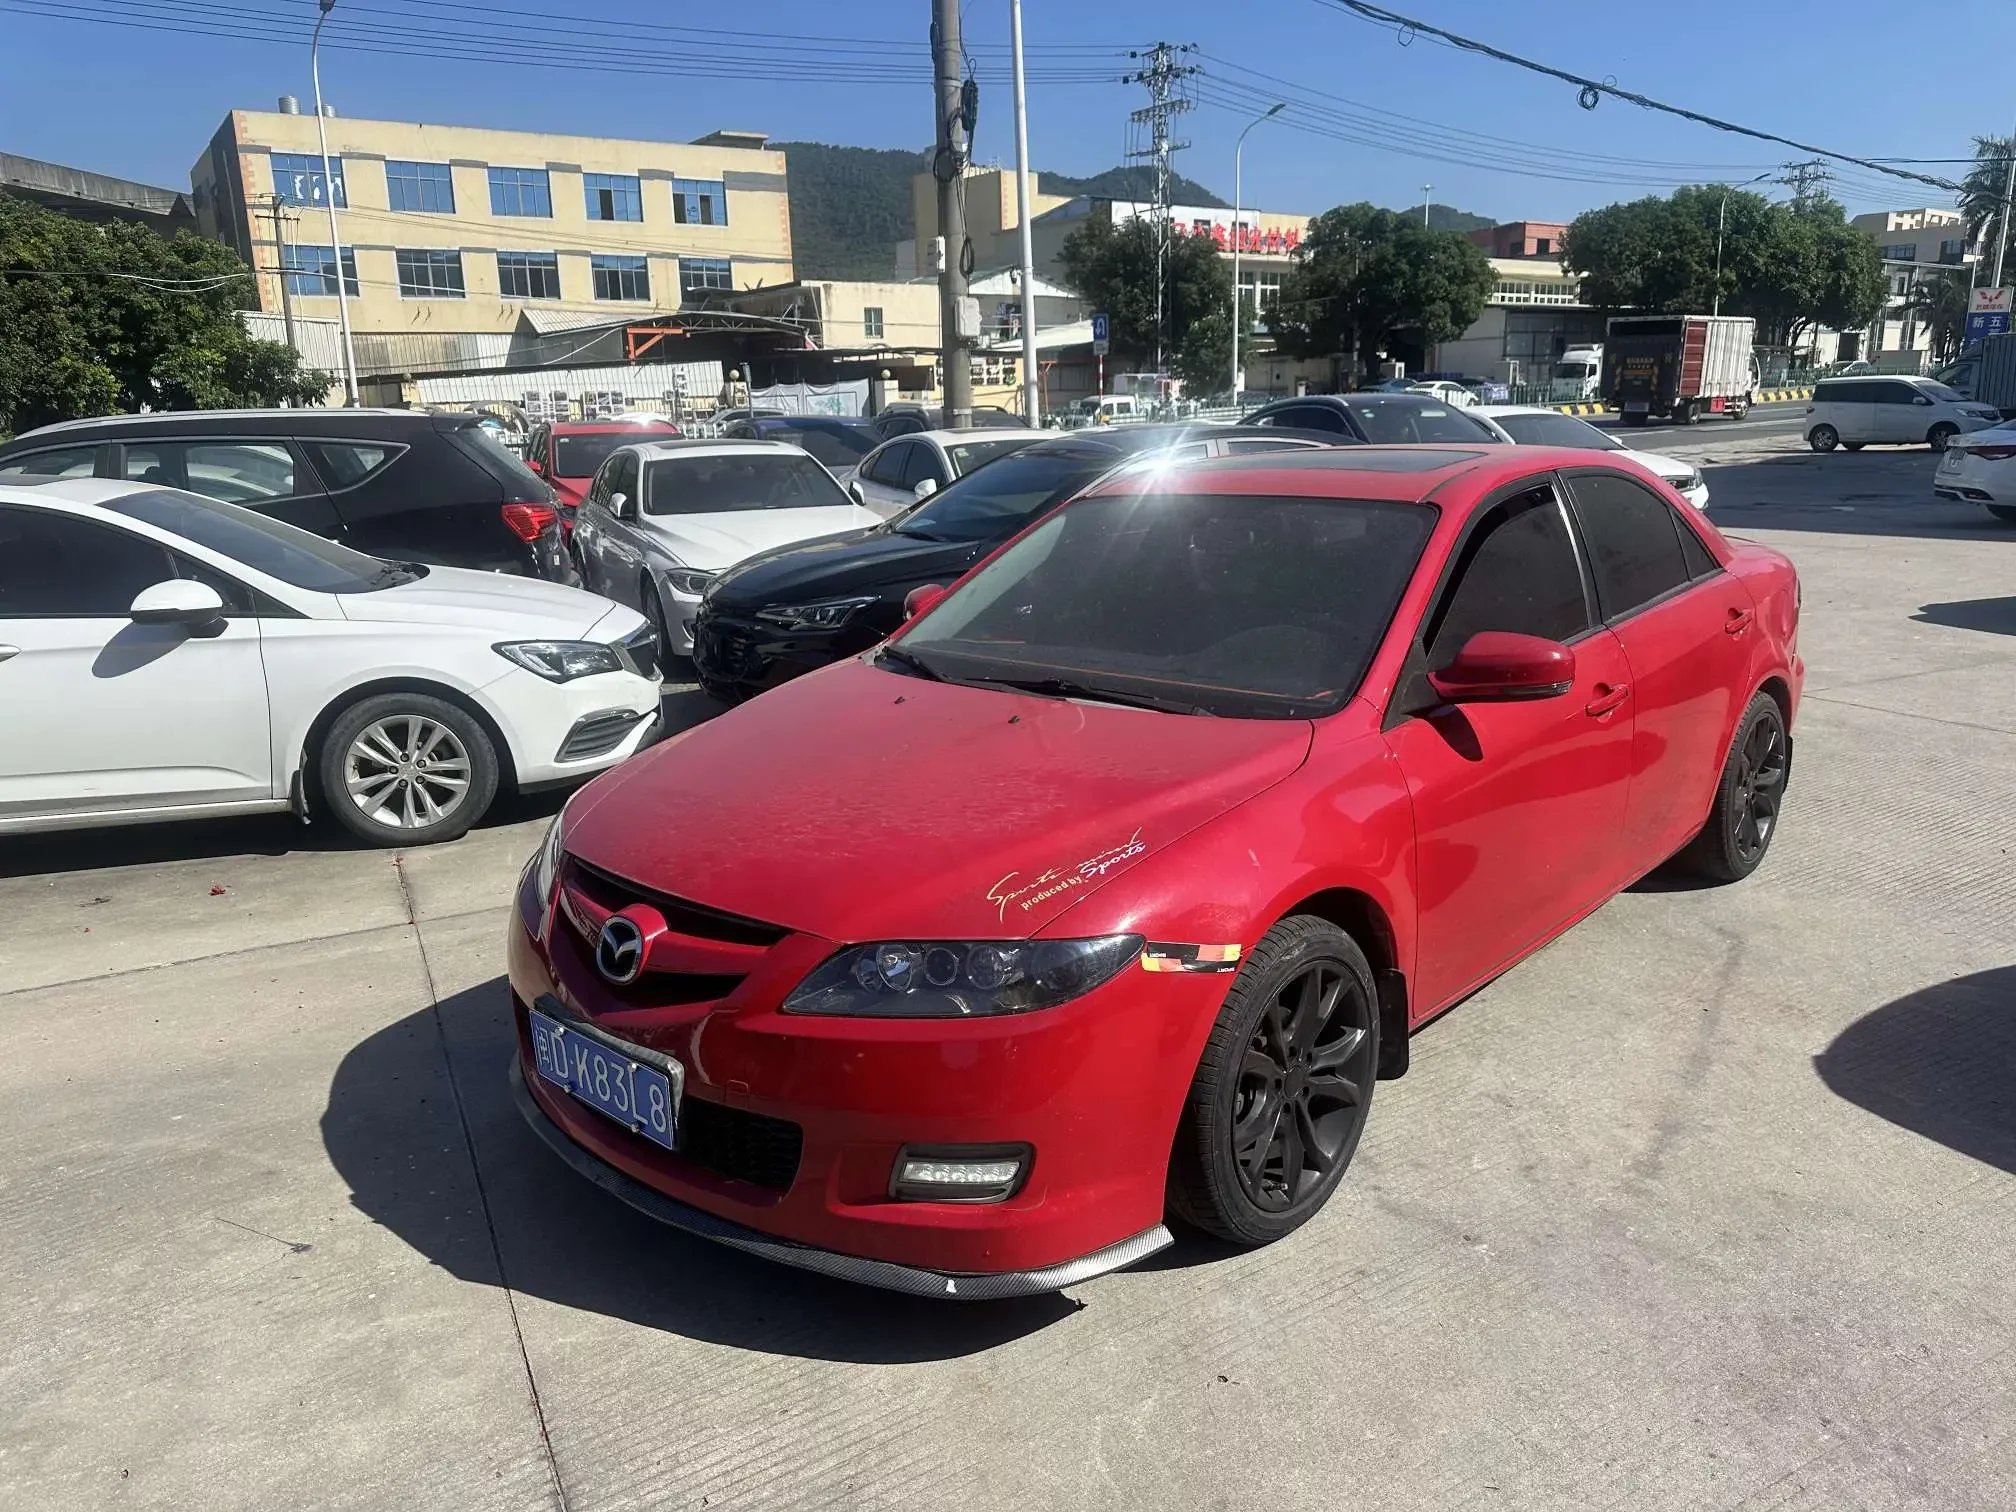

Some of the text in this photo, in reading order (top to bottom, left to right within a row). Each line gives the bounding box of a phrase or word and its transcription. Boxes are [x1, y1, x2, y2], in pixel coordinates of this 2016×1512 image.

[1020, 840, 1146, 911] produced by Sports
